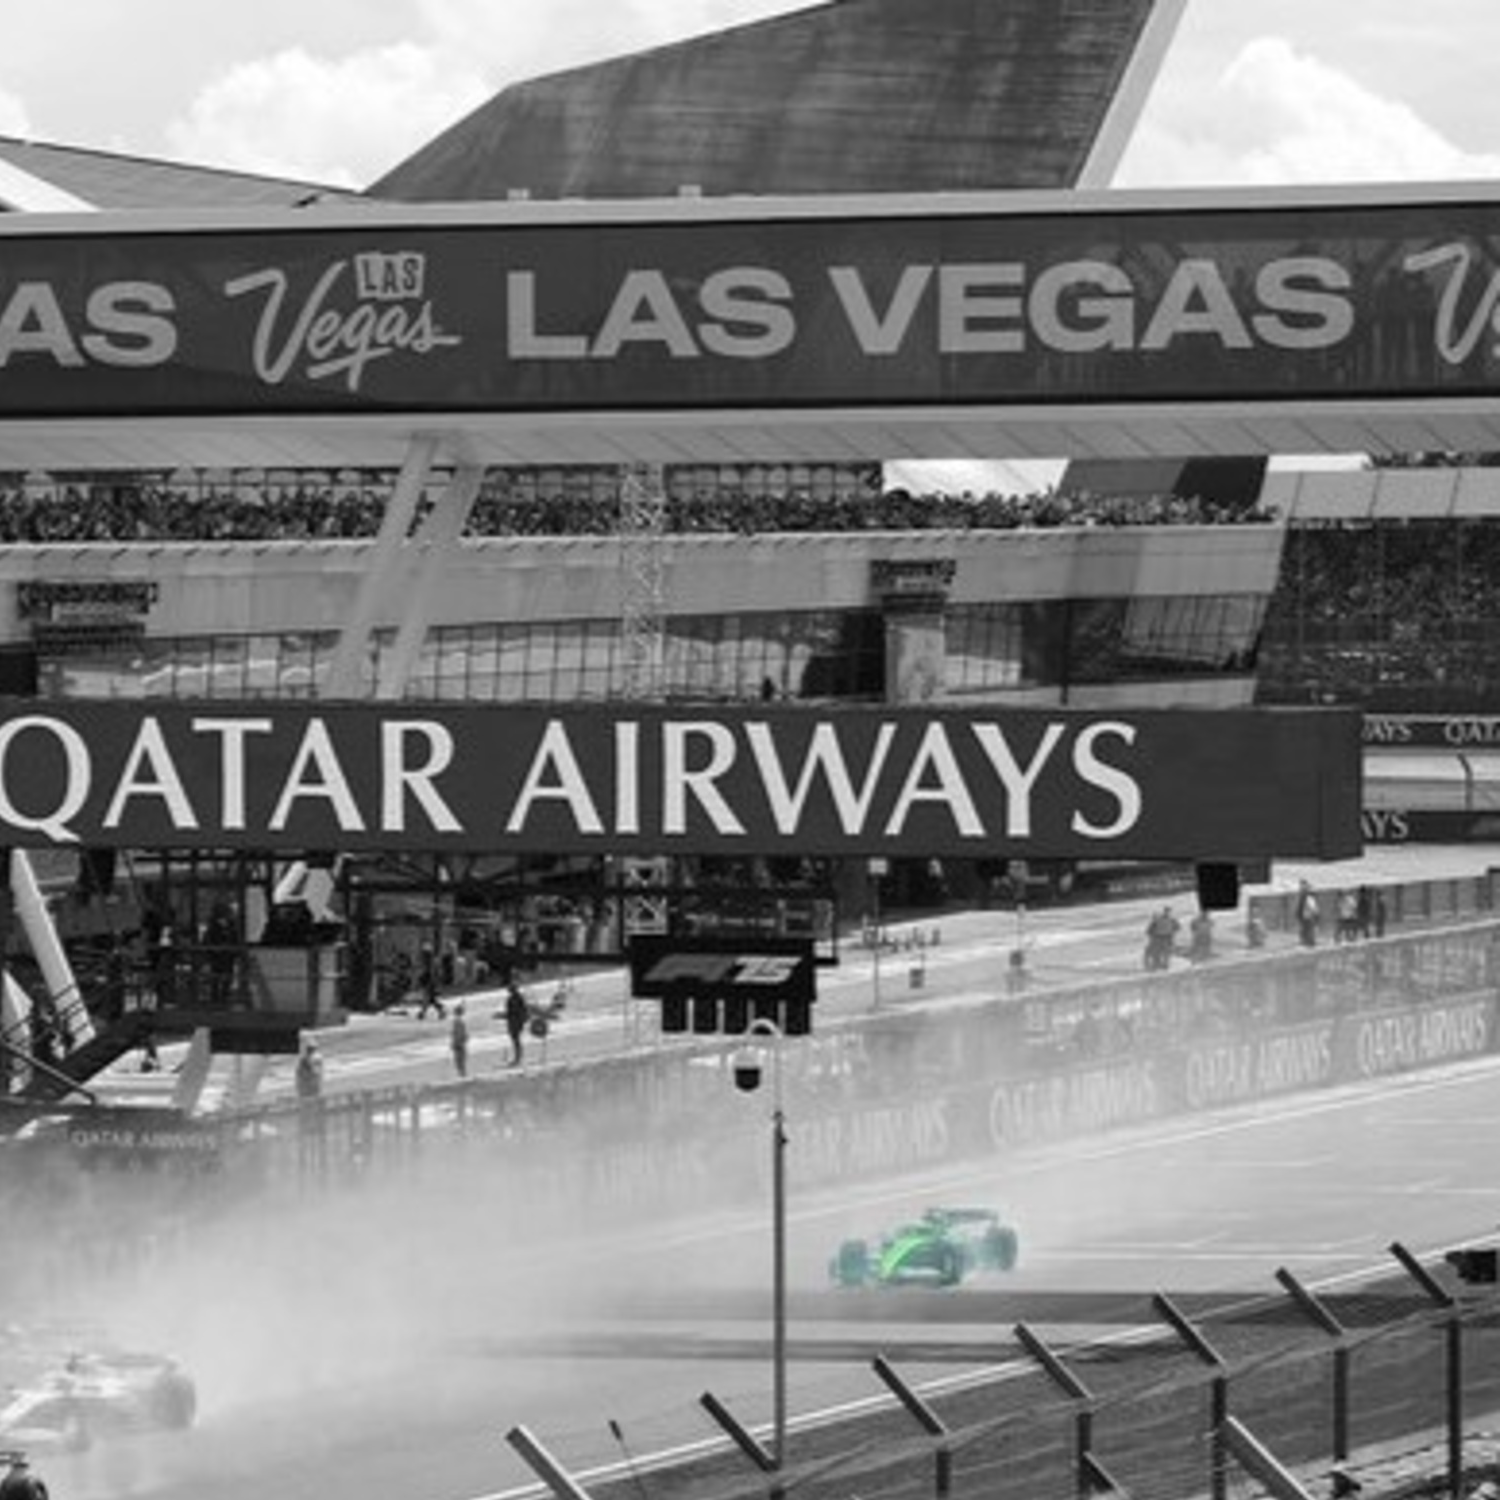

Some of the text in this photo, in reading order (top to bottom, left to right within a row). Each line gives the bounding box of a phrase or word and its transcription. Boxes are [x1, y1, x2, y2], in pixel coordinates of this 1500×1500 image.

[363, 257, 418, 293] LAS
[506, 267, 795, 358] LAS
[828, 257, 1355, 353] VEGAS
[225, 262, 461, 390] Vegas
[506, 719, 1142, 838] AIRWAYS
[1444, 722, 1500, 744] QAT
